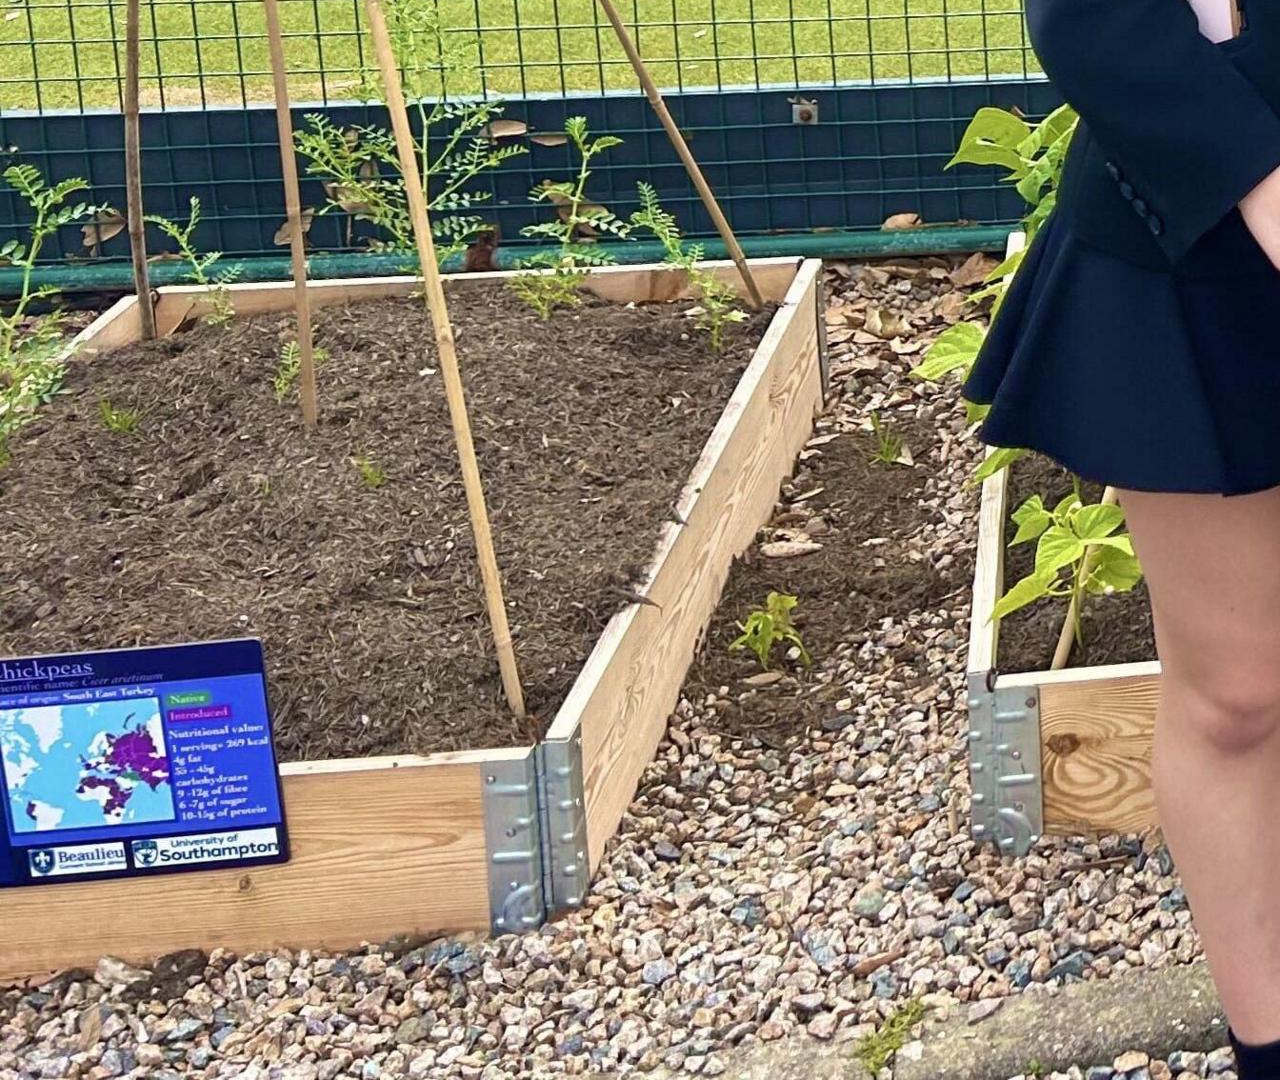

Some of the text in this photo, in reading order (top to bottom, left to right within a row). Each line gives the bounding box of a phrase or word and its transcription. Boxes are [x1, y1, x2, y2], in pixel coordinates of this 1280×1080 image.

[0, 659, 93, 680] hickpeas
[62, 689, 94, 701] South
[120, 685, 156, 697] Turkey
[168, 694, 206, 705] Native
[169, 706, 228, 721] Introduced
[168, 725, 229, 740] Nutritional
[230, 805, 267, 818] protein
[170, 833, 239, 849] University of
[58, 848, 125, 863] Beaulieu
[159, 841, 279, 863] Southampton
